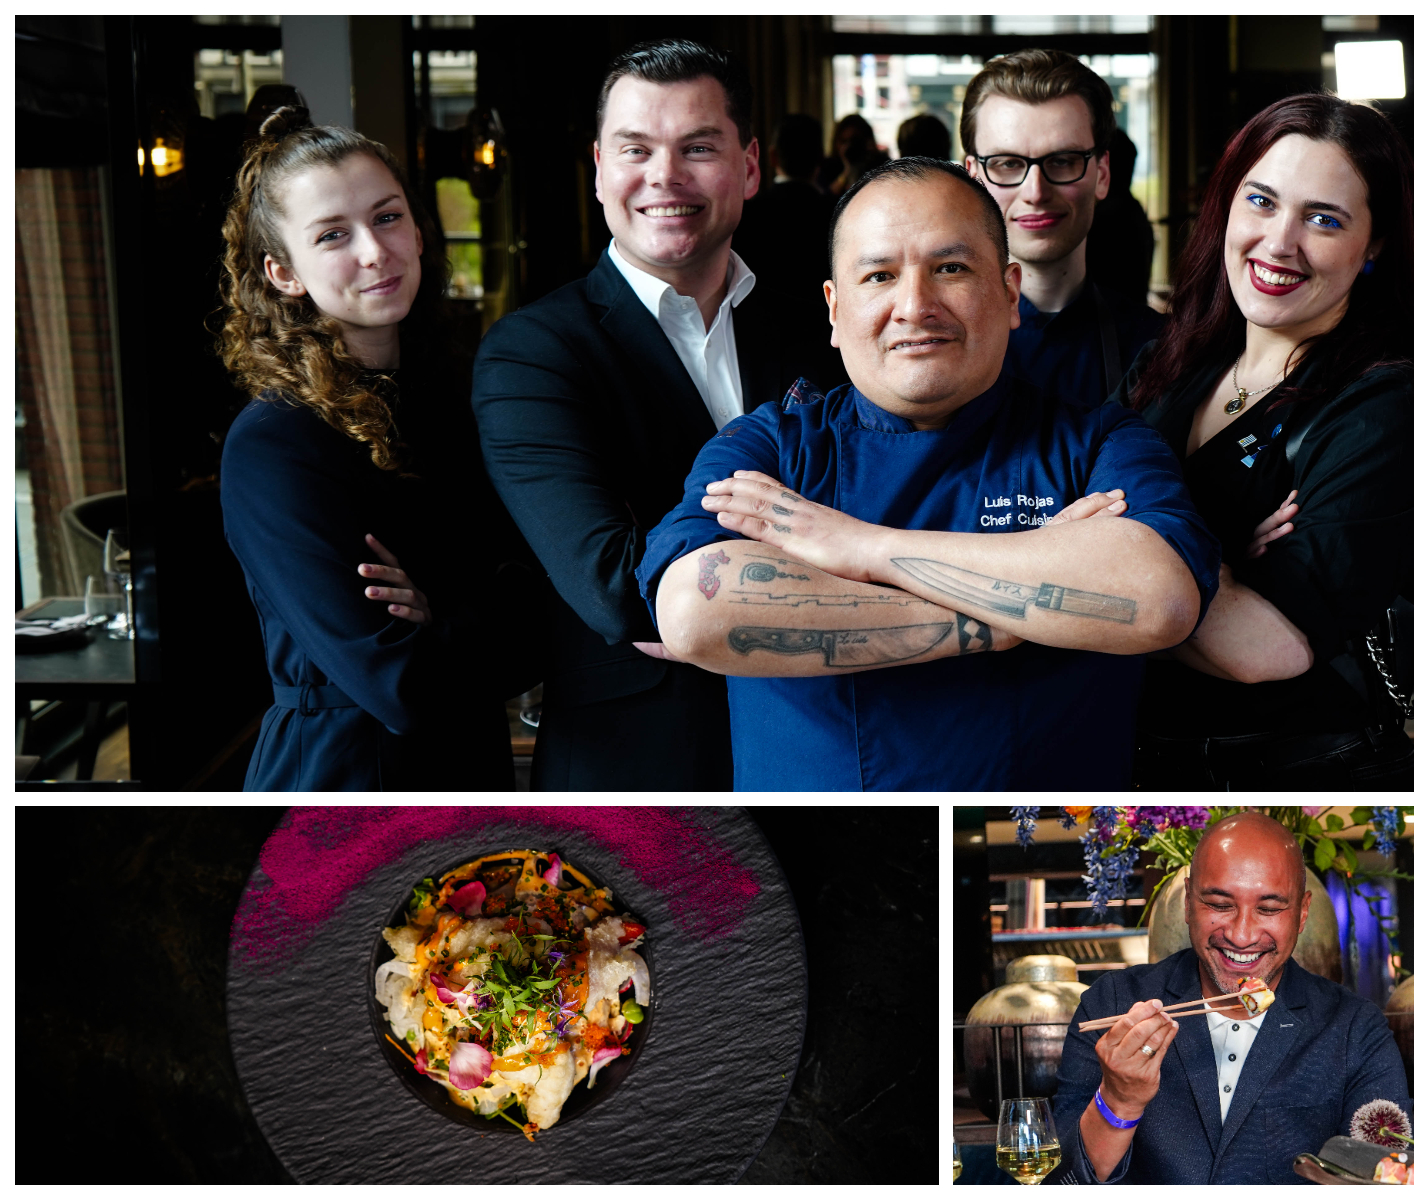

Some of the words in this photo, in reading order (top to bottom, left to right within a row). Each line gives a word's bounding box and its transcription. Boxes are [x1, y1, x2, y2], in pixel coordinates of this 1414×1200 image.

[984, 495, 1012, 508] Luis
[1017, 494, 1055, 510] Rojas
[980, 512, 1012, 527] Chef
